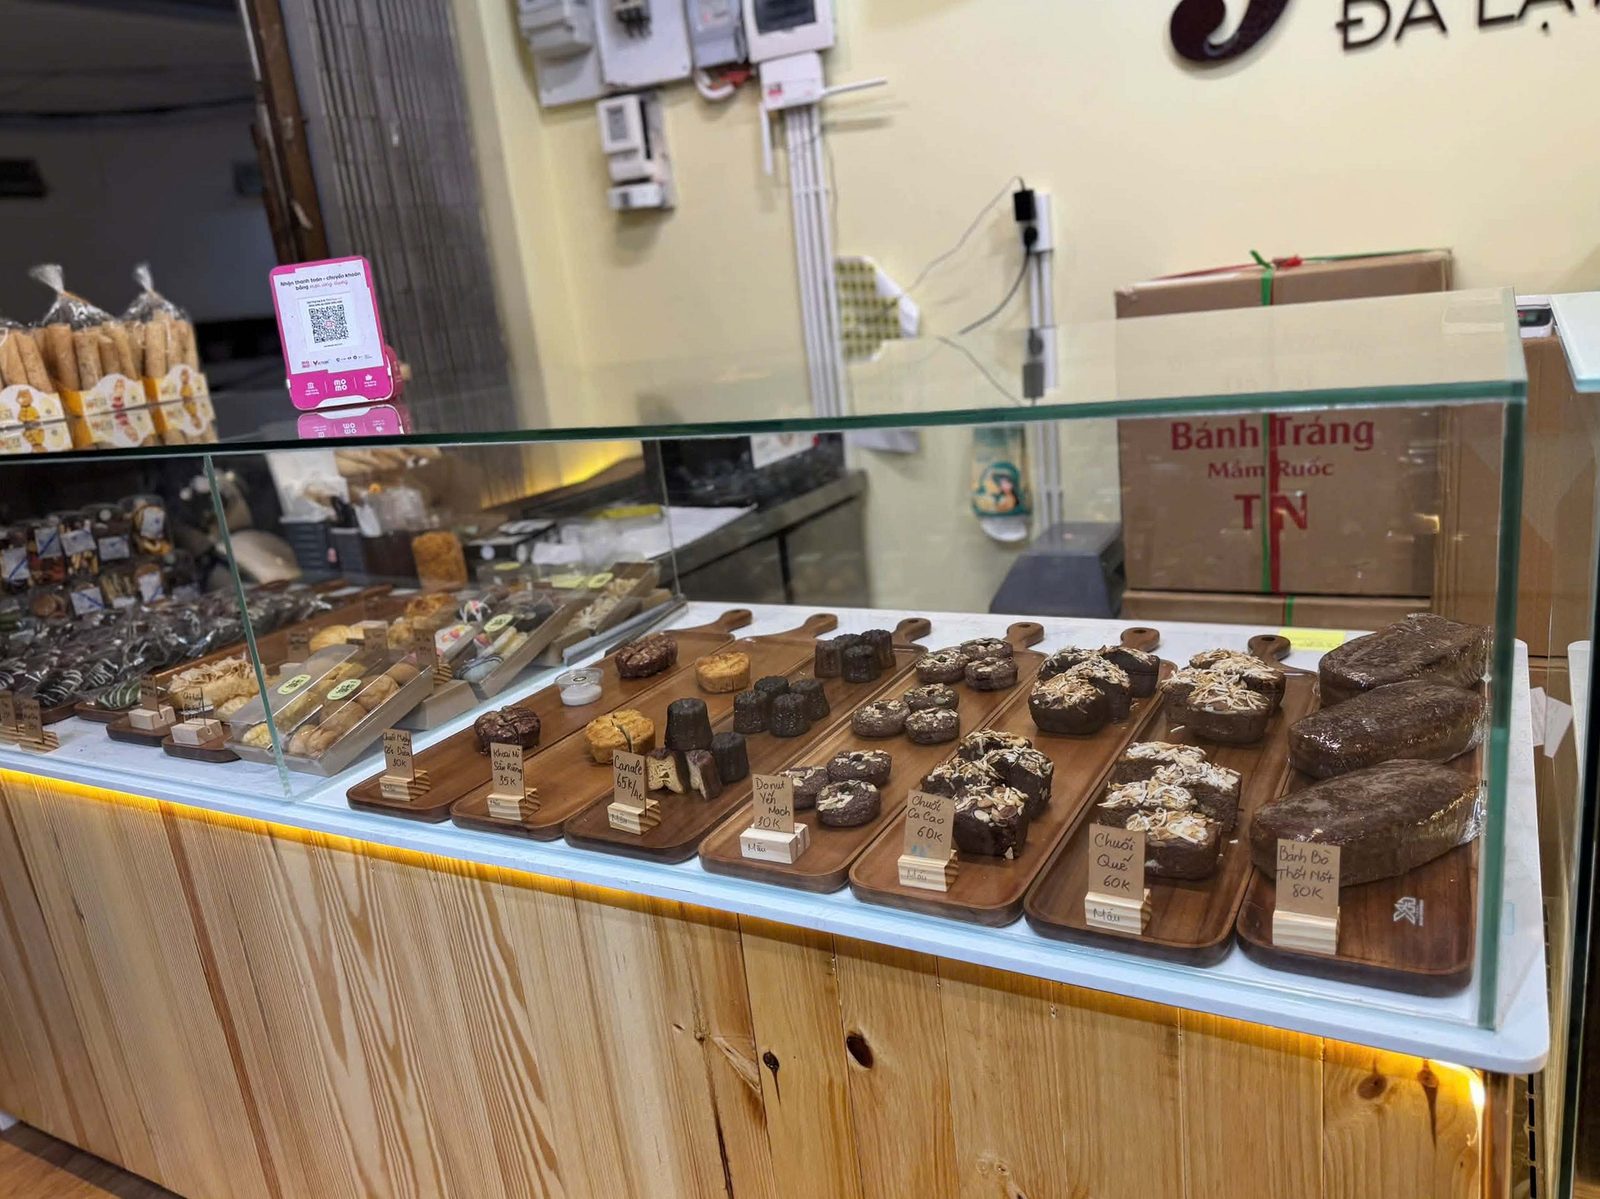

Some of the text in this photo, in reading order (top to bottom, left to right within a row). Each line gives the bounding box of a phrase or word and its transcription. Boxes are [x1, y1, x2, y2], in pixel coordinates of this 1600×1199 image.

[1171, 415, 1375, 452] Bánh Tráng
[755, 777, 785, 790] Donut
[907, 807, 945, 825] Ca Cao
[1094, 832, 1136, 851] Chuối
[1097, 852, 1134, 872] Quế
[1280, 844, 1307, 863] Bánh
